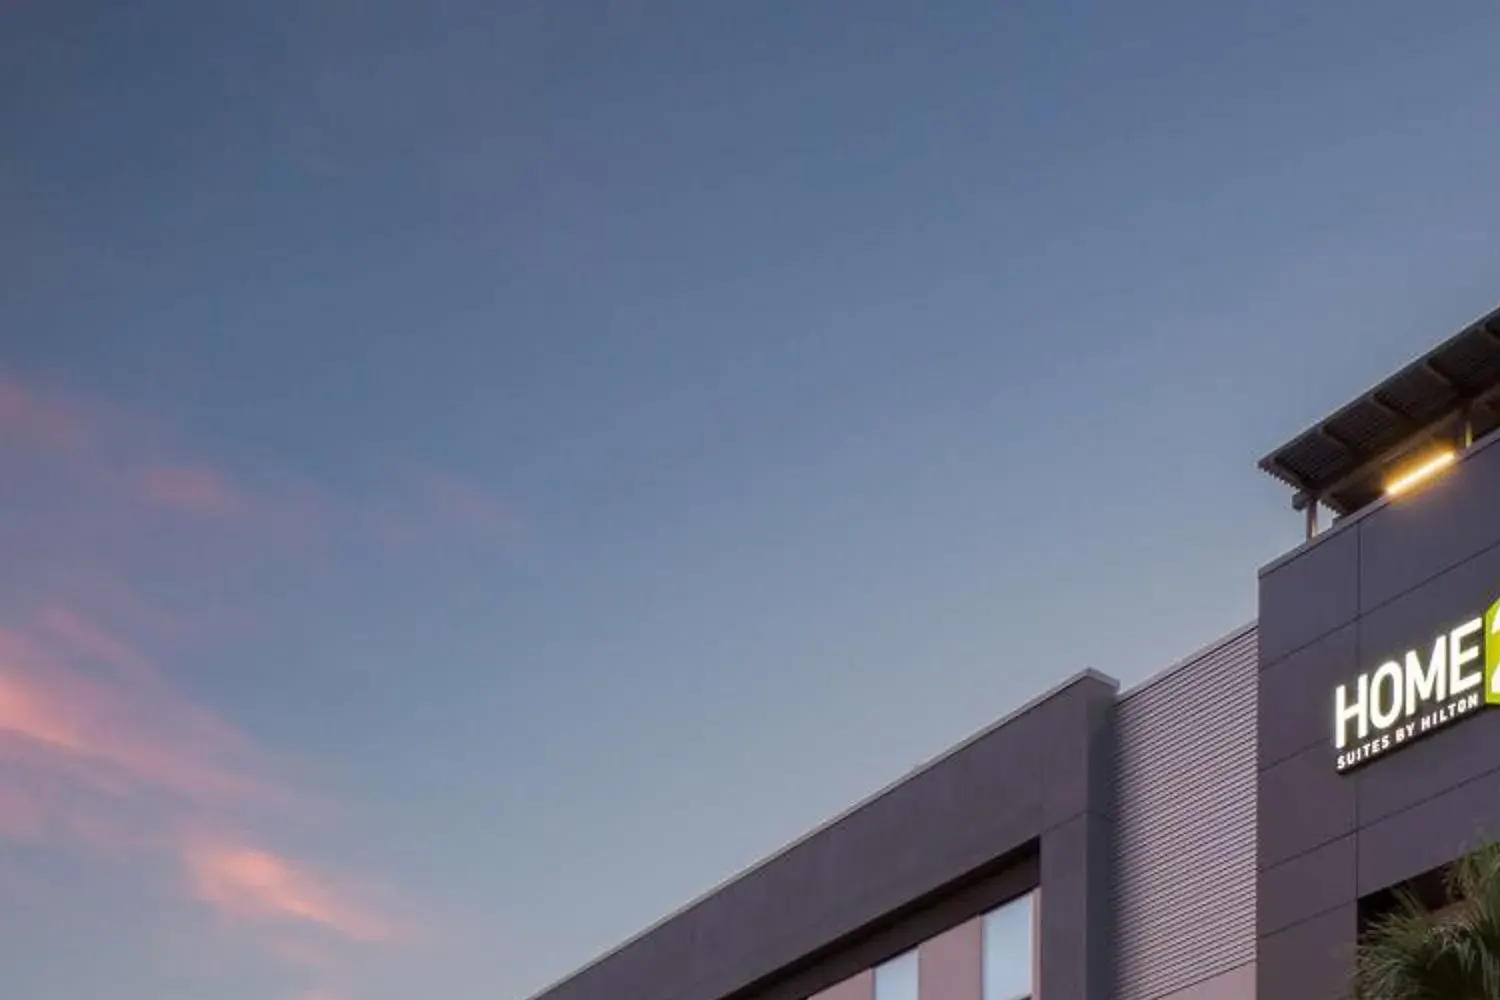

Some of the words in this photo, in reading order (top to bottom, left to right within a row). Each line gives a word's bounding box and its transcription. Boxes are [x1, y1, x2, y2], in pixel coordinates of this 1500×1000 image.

[1335, 616, 1483, 749] HOME
[1337, 735, 1390, 769] SUITES
[1395, 722, 1415, 742] BY
[1421, 693, 1480, 731] HILTON
